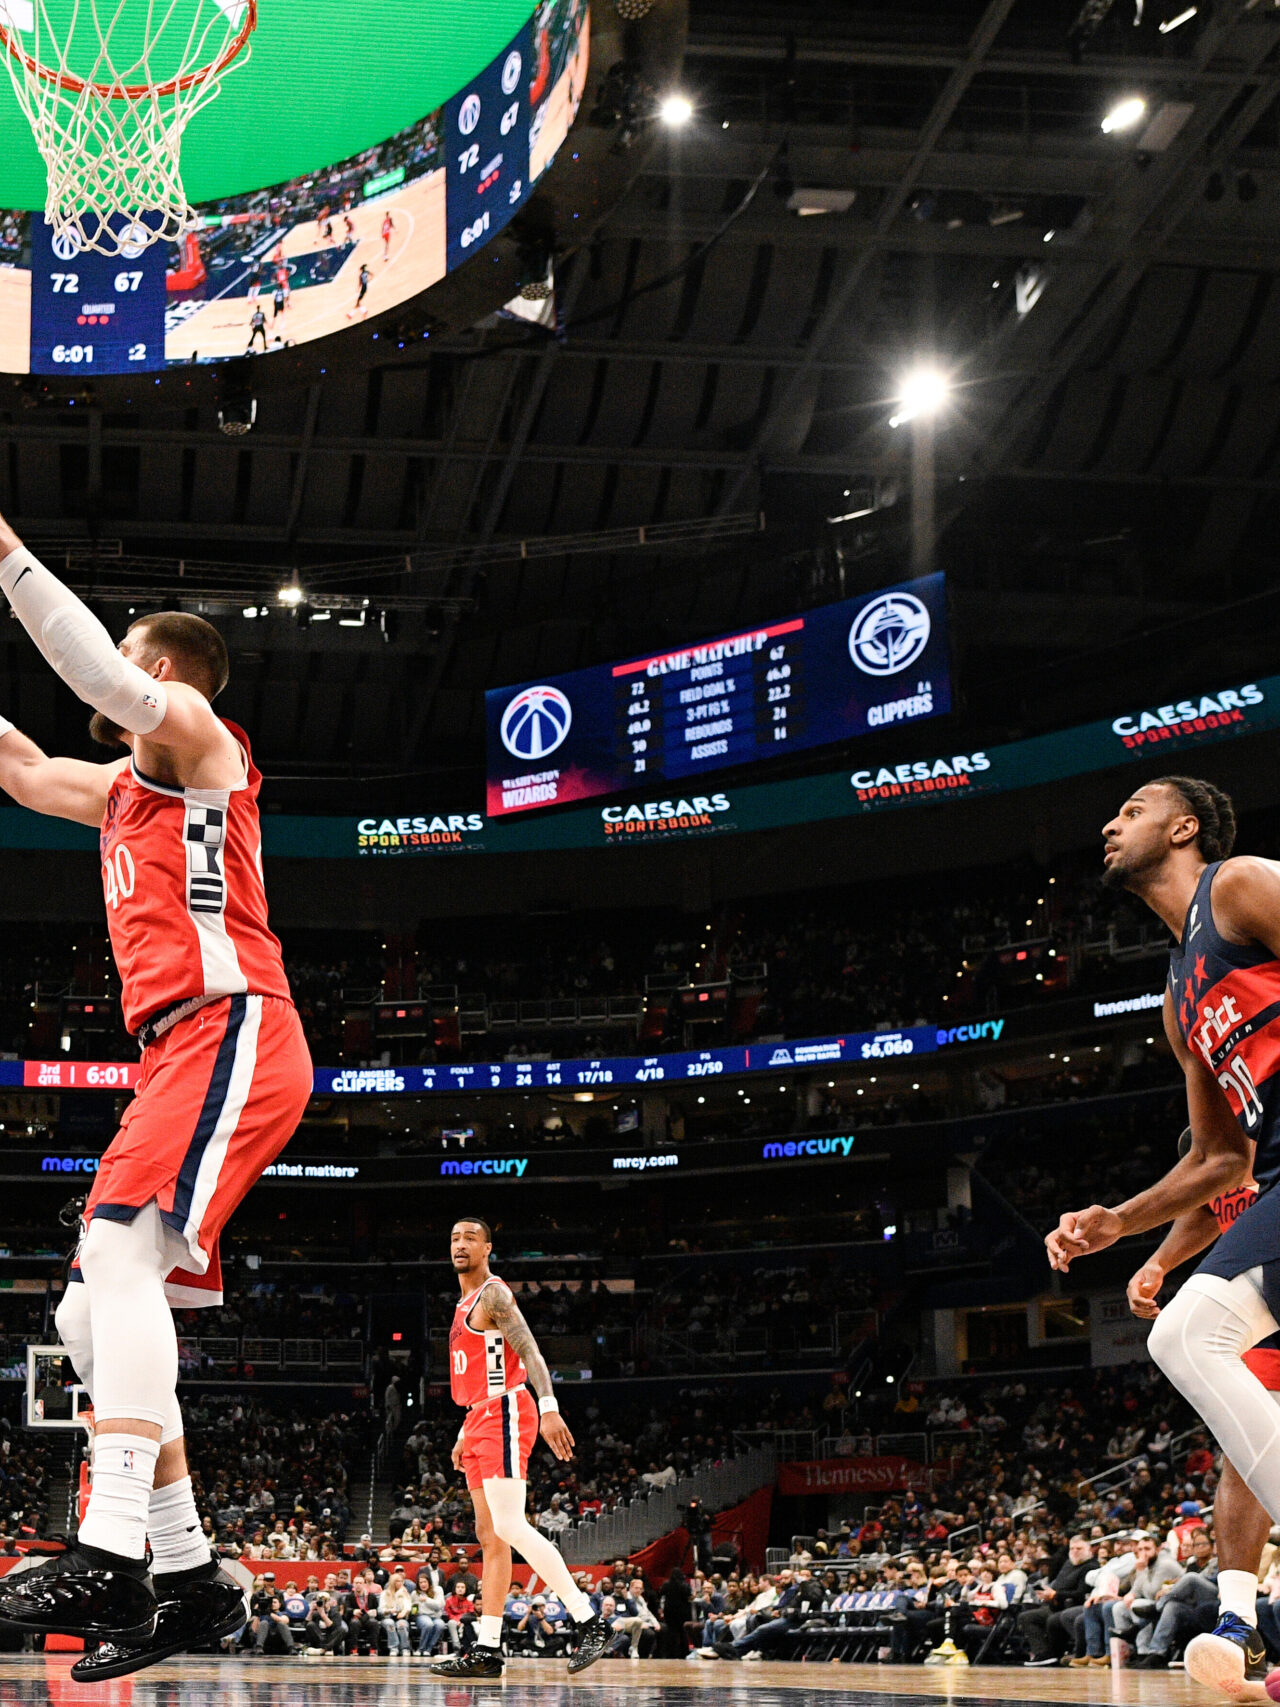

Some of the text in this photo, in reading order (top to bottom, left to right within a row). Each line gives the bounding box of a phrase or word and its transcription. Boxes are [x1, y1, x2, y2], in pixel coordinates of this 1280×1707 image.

[50, 271, 143, 293] 72 67
[52, 343, 146, 363] 6:01 :2
[646, 632, 768, 677] GAME MATCHUP
[690, 662, 724, 682] POINTS
[679, 685, 703, 703] FIELD
[867, 692, 933, 727] CLIPPERS
[1112, 684, 1264, 736] CAESARS
[684, 718, 733, 742] REBOUNDS
[1122, 709, 1245, 749] SPORTSBOOK
[690, 739, 728, 760] ASSISTS
[851, 752, 990, 789] CAESARS
[502, 782, 557, 808] WIZARDS
[856, 773, 970, 801] SPORTSBOOK
[601, 793, 731, 823] CAESARS
[357, 814, 483, 835] CAESARS
[604, 813, 712, 834] SPORTSBOOK
[358, 832, 462, 846] SPORTSBOOK
[104, 843, 135, 910] 40
[861, 1039, 913, 1059] $6,060
[39, 1064, 60, 1076] 3rd
[86, 1066, 129, 1085] 6:01
[341, 1070, 396, 1079] LOS ANGELES
[450, 1067, 474, 1075] FOULS
[490, 1065, 501, 1073] TO
[577, 1070, 613, 1084] 17/18
[635, 1067, 665, 1082] 4/18
[687, 1061, 723, 1077] 23/50
[38, 1075, 61, 1086] QTR
[332, 1076, 405, 1093] CLIPPERS
[424, 1078, 433, 1089] 4
[458, 1077, 465, 1088] 1
[491, 1075, 500, 1087] 9
[516, 1074, 532, 1086] 24
[546, 1073, 561, 1085] 14
[1218, 1055, 1263, 1127] 20
[763, 1135, 854, 1158] mercury
[277, 1163, 303, 1176] that
[440, 1158, 528, 1177] mercury
[613, 1154, 678, 1169] mrcy.com
[806, 1465, 897, 1488] Hennessy
